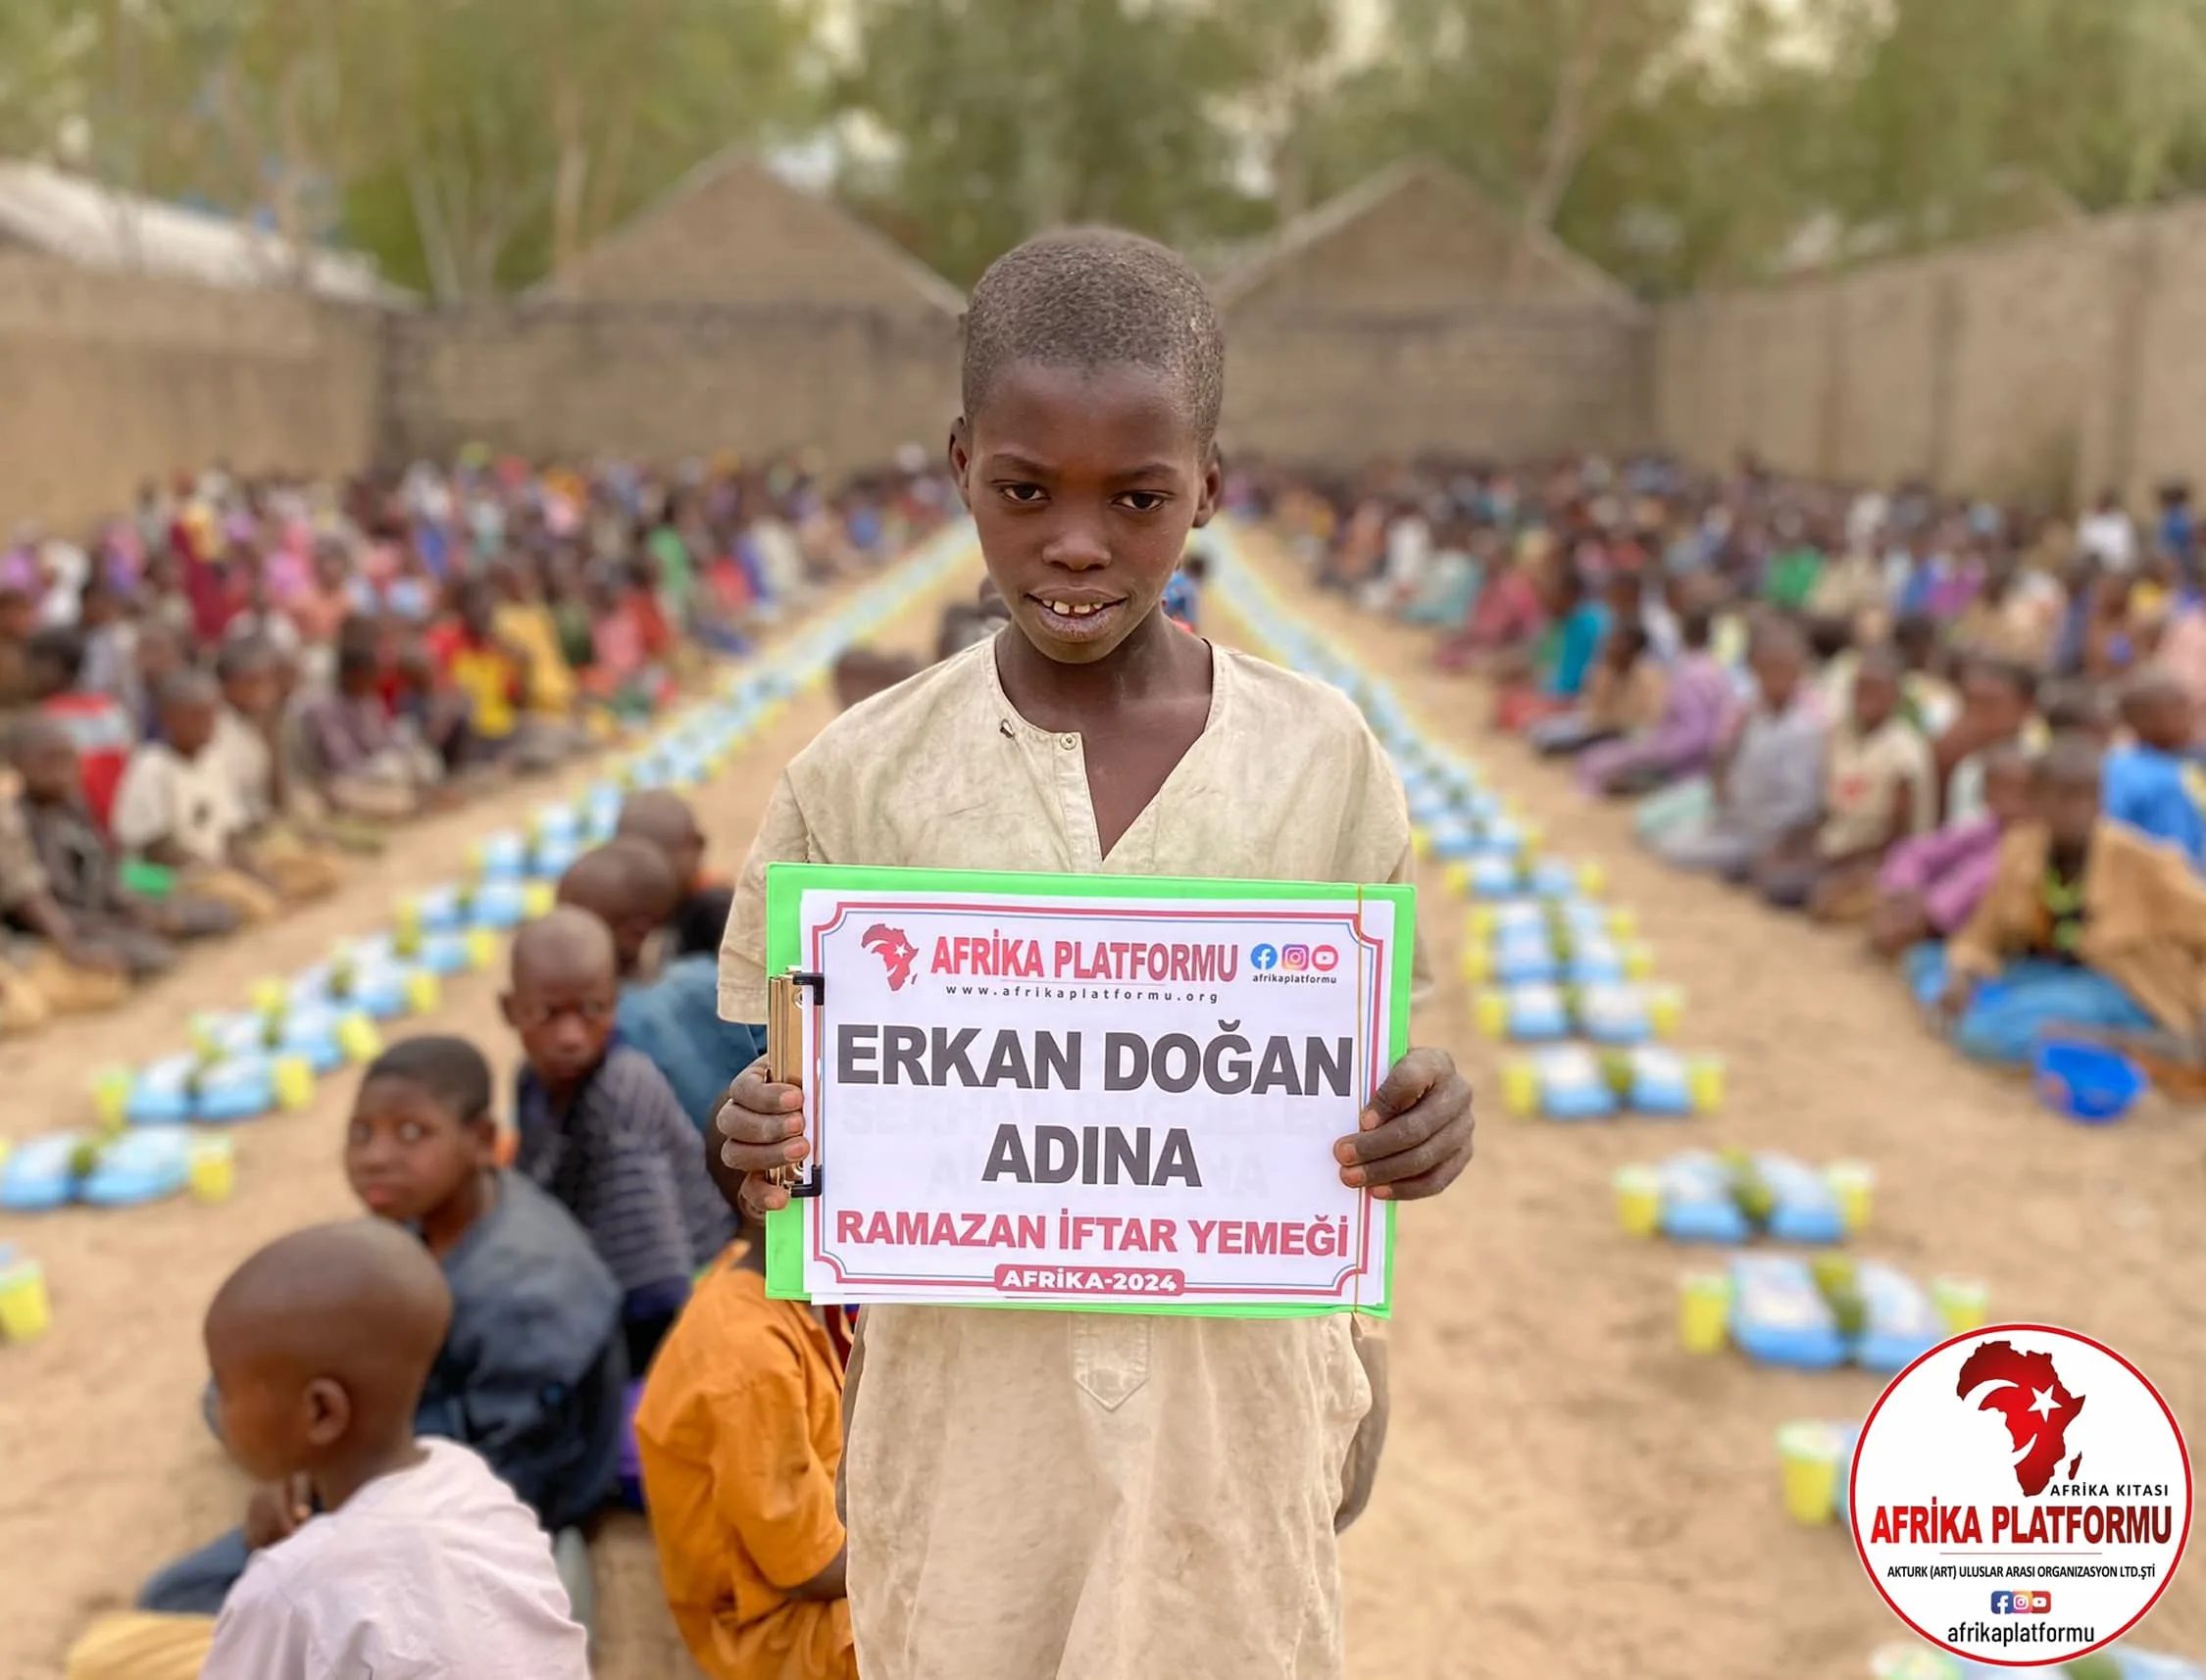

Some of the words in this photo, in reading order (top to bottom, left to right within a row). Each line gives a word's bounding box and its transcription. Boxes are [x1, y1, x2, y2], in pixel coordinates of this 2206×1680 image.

[930, 929, 1044, 978] AFRİKA
[1054, 940, 1239, 983] PLATFORMU
[1252, 973, 1337, 985] afrikaplatformu
[946, 984, 1220, 1005] www.afrikaplatformu.org
[836, 1023, 1082, 1092] ERKAN
[1103, 1018, 1354, 1097] DOĞAN
[981, 1123, 1202, 1188] ADINA
[836, 1211, 1047, 1250] RAMAZAN
[1058, 1209, 1178, 1254] İFTAR
[1188, 1214, 1349, 1258] YEMEĞİ
[1001, 1268, 1178, 1294] AFRİKA-2024
